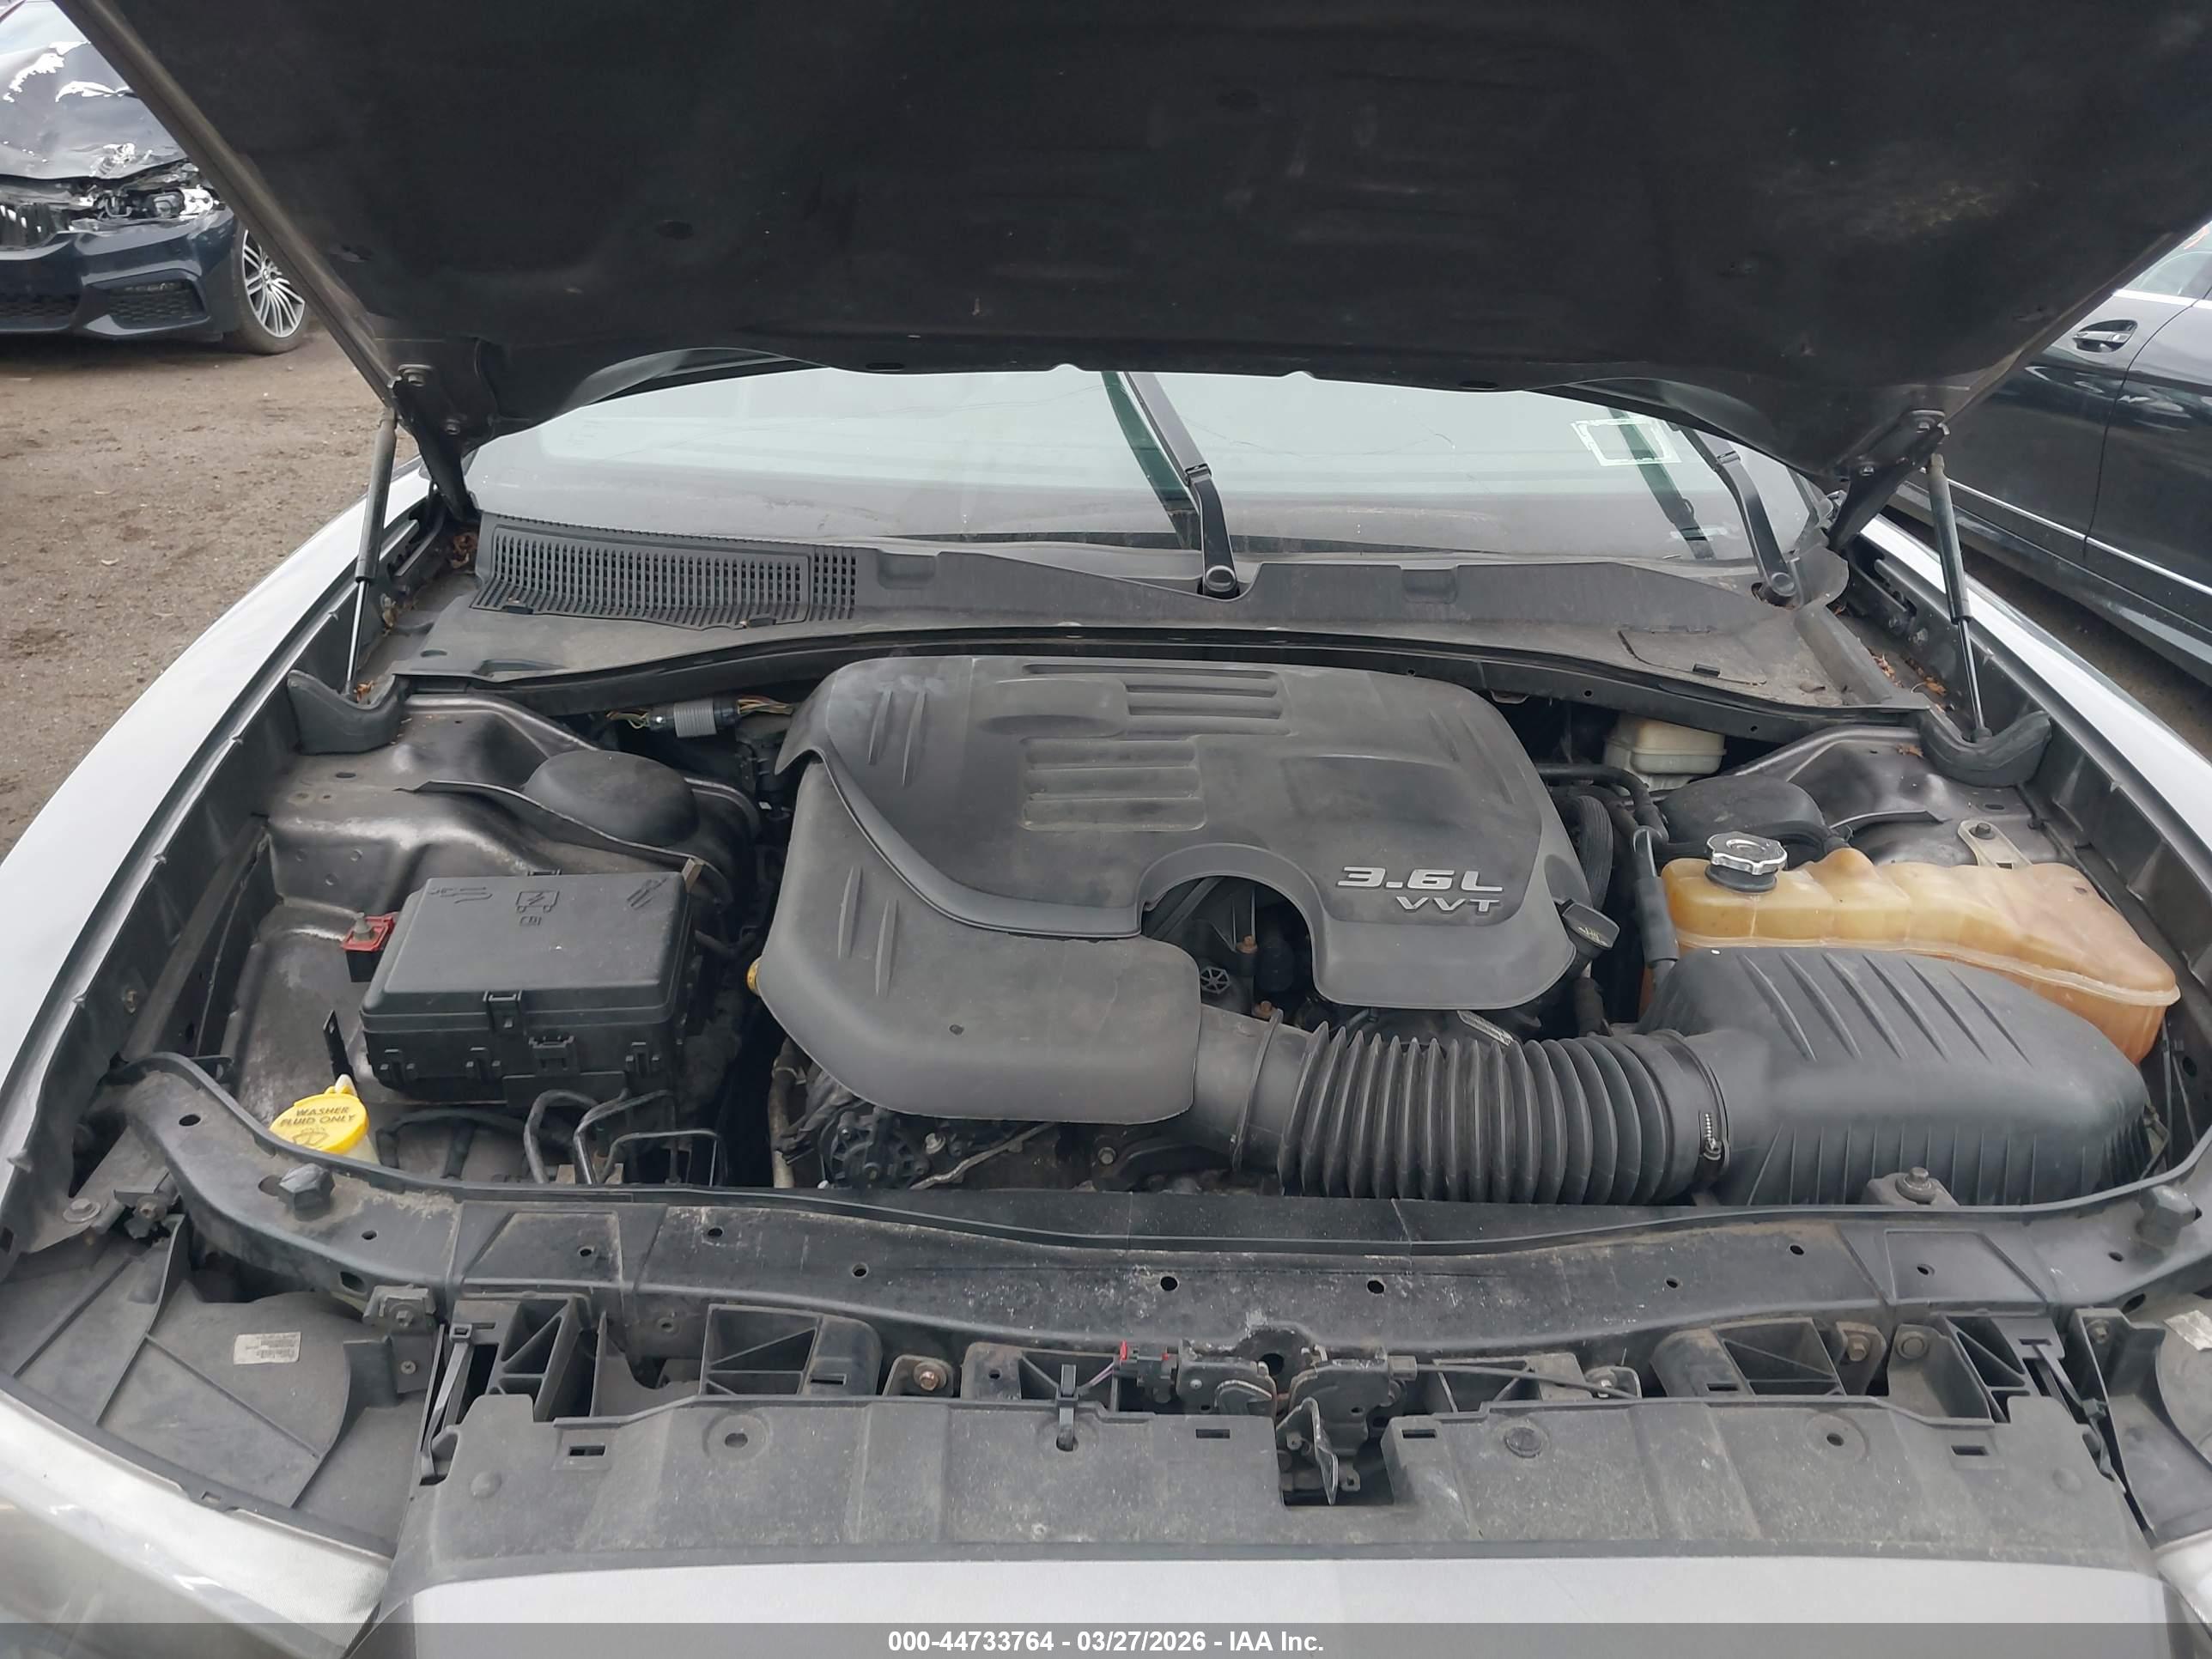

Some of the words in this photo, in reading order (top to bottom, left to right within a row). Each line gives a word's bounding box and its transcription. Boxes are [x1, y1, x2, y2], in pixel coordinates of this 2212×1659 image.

[1337, 866, 1503, 892] 3.6L
[1395, 896, 1500, 913] VVT
[296, 1107, 349, 1116] WASHER
[280, 1117, 315, 1127] FLUID
[319, 1114, 356, 1123] ONLY
